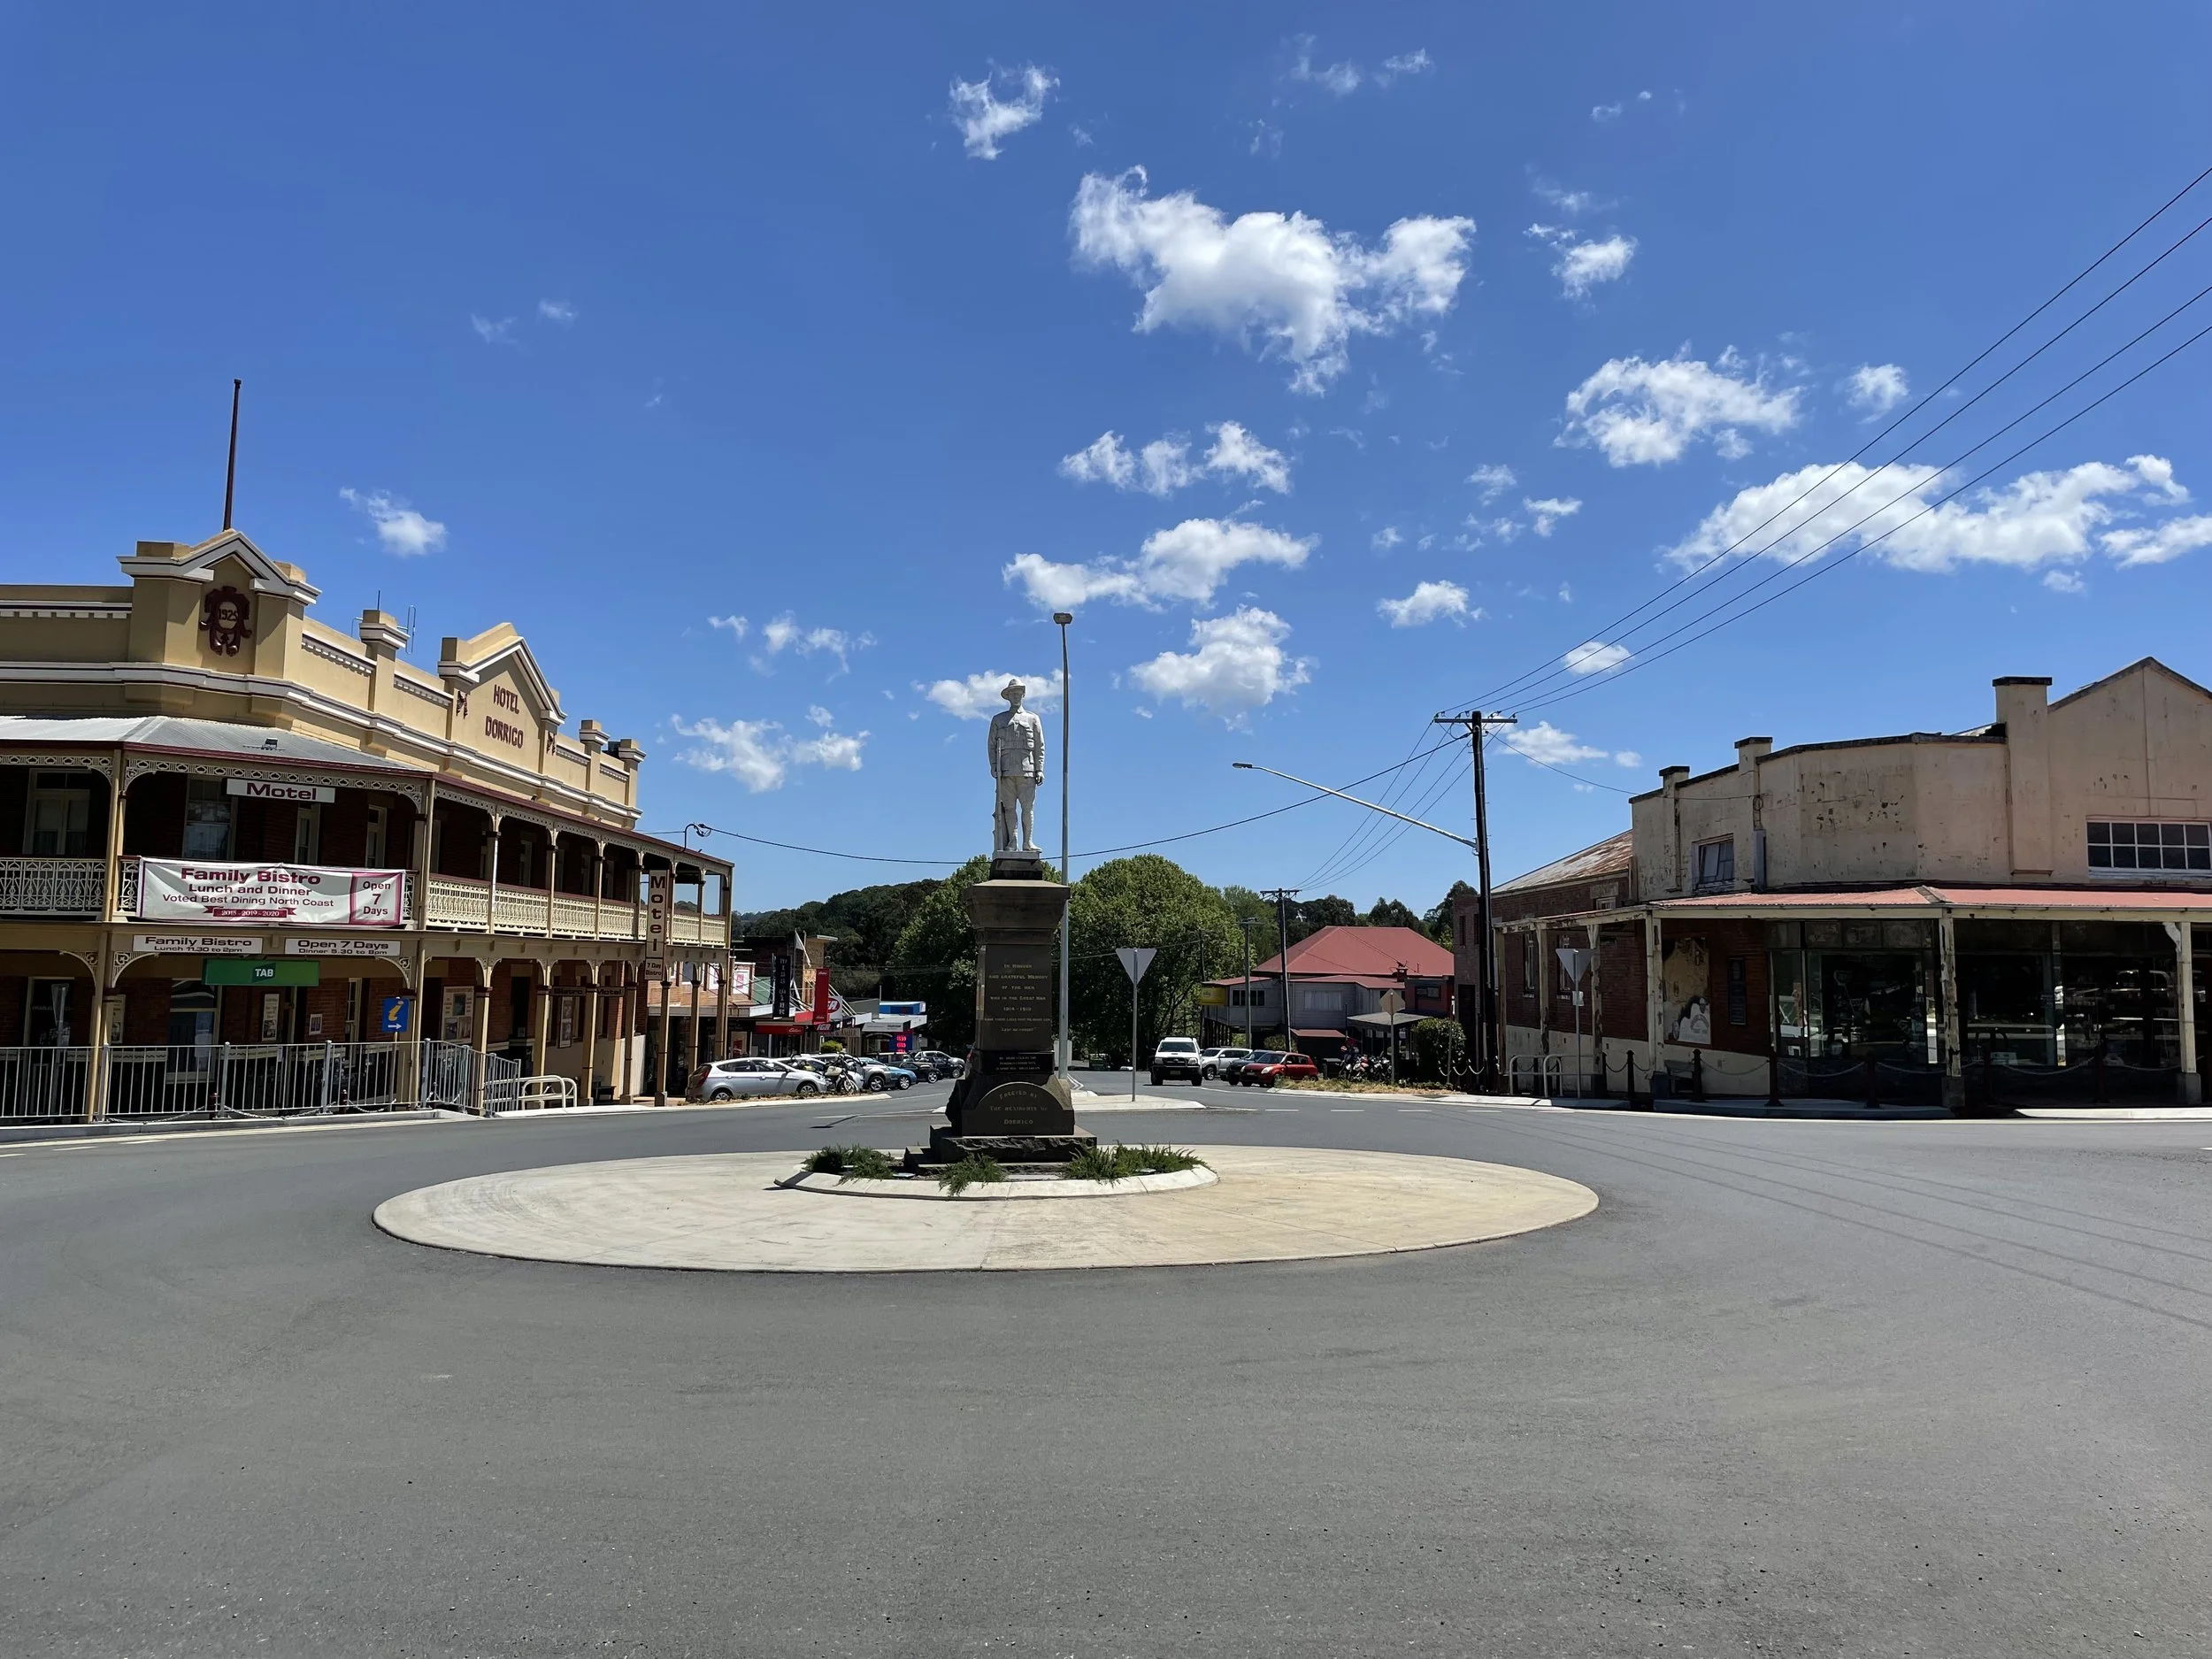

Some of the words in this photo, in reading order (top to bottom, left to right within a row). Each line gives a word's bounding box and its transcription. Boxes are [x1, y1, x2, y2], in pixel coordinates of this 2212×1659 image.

[494, 684, 519, 714] HOTEL
[485, 715, 524, 749] DORRIGO
[246, 782, 317, 800] Motel
[180, 867, 250, 885] Family
[257, 870, 321, 885] Bistro
[188, 883, 233, 894] Lunch
[237, 886, 264, 895] and
[267, 886, 312, 896] Dinner
[363, 880, 391, 891] Open
[162, 894, 197, 902] Voted
[201, 895, 228, 903] Best
[231, 895, 265, 906] Dining
[269, 896, 299, 906] North
[303, 898, 334, 908] Coast
[372, 894, 381, 904] 7
[363, 906, 388, 917] Days
[649, 876, 666, 951] Motel
[144, 936, 197, 947] Family
[297, 940, 337, 949] Open
[353, 941, 389, 949] Days
[255, 968, 274, 977] TAB
